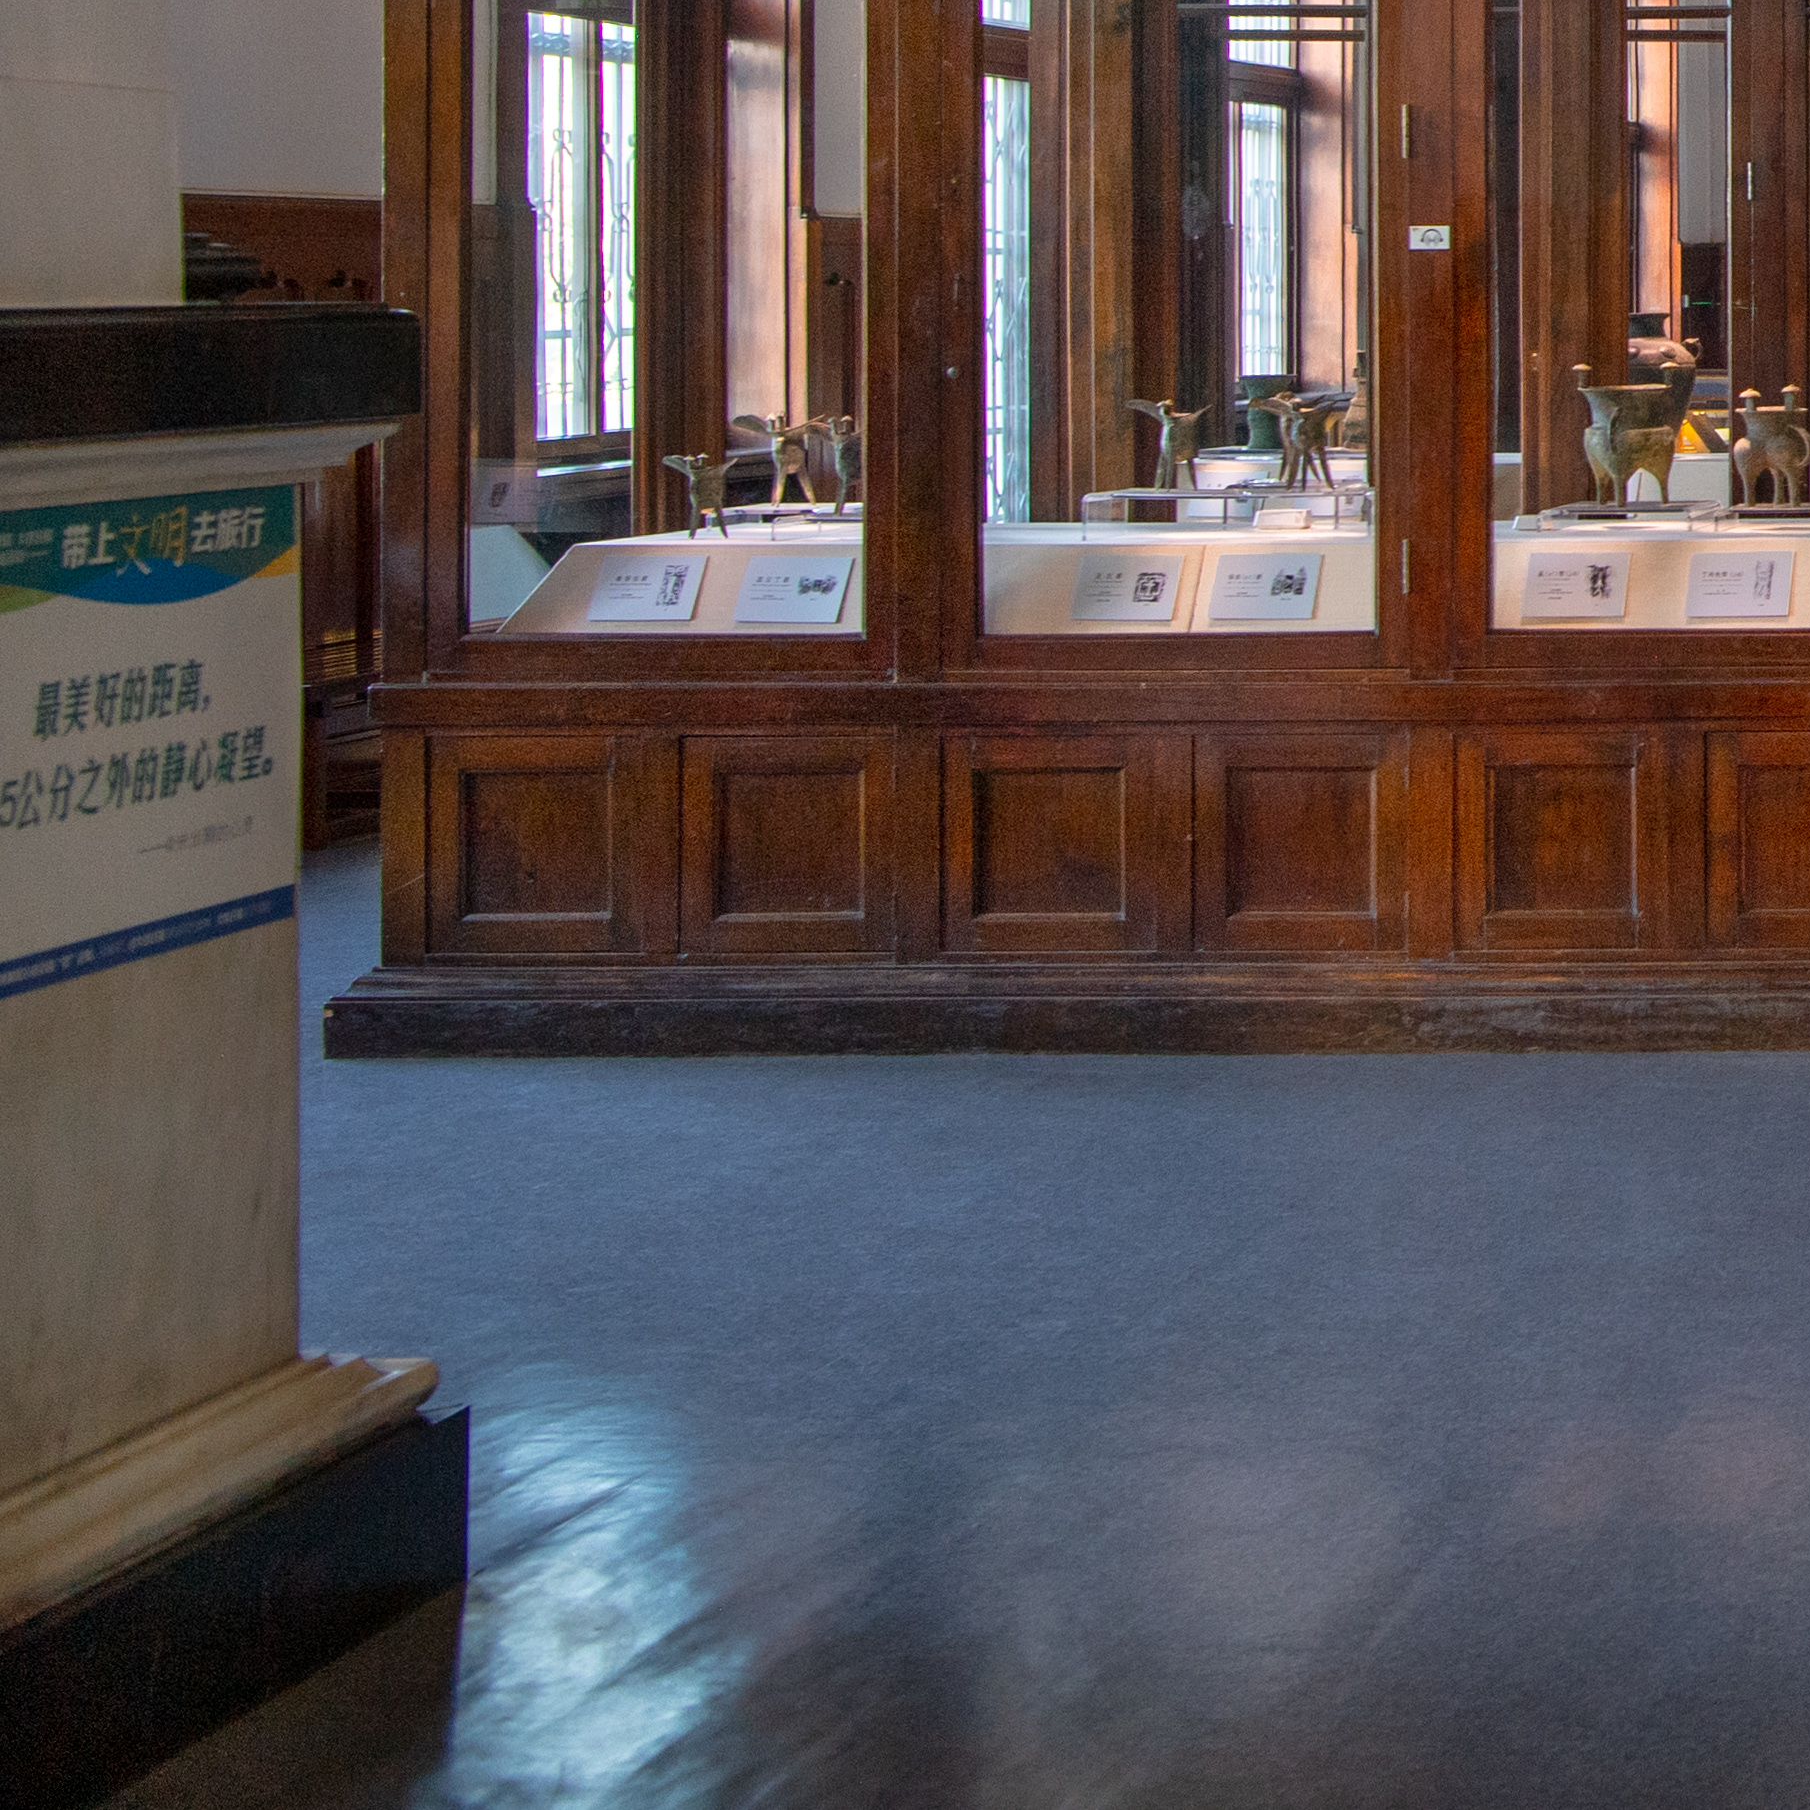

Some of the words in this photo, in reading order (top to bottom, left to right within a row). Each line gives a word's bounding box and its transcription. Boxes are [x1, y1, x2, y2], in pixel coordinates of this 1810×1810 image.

[61, 505, 265, 576] 带上文明去旅行
[33, 659, 211, 740] 最美好的距离，
